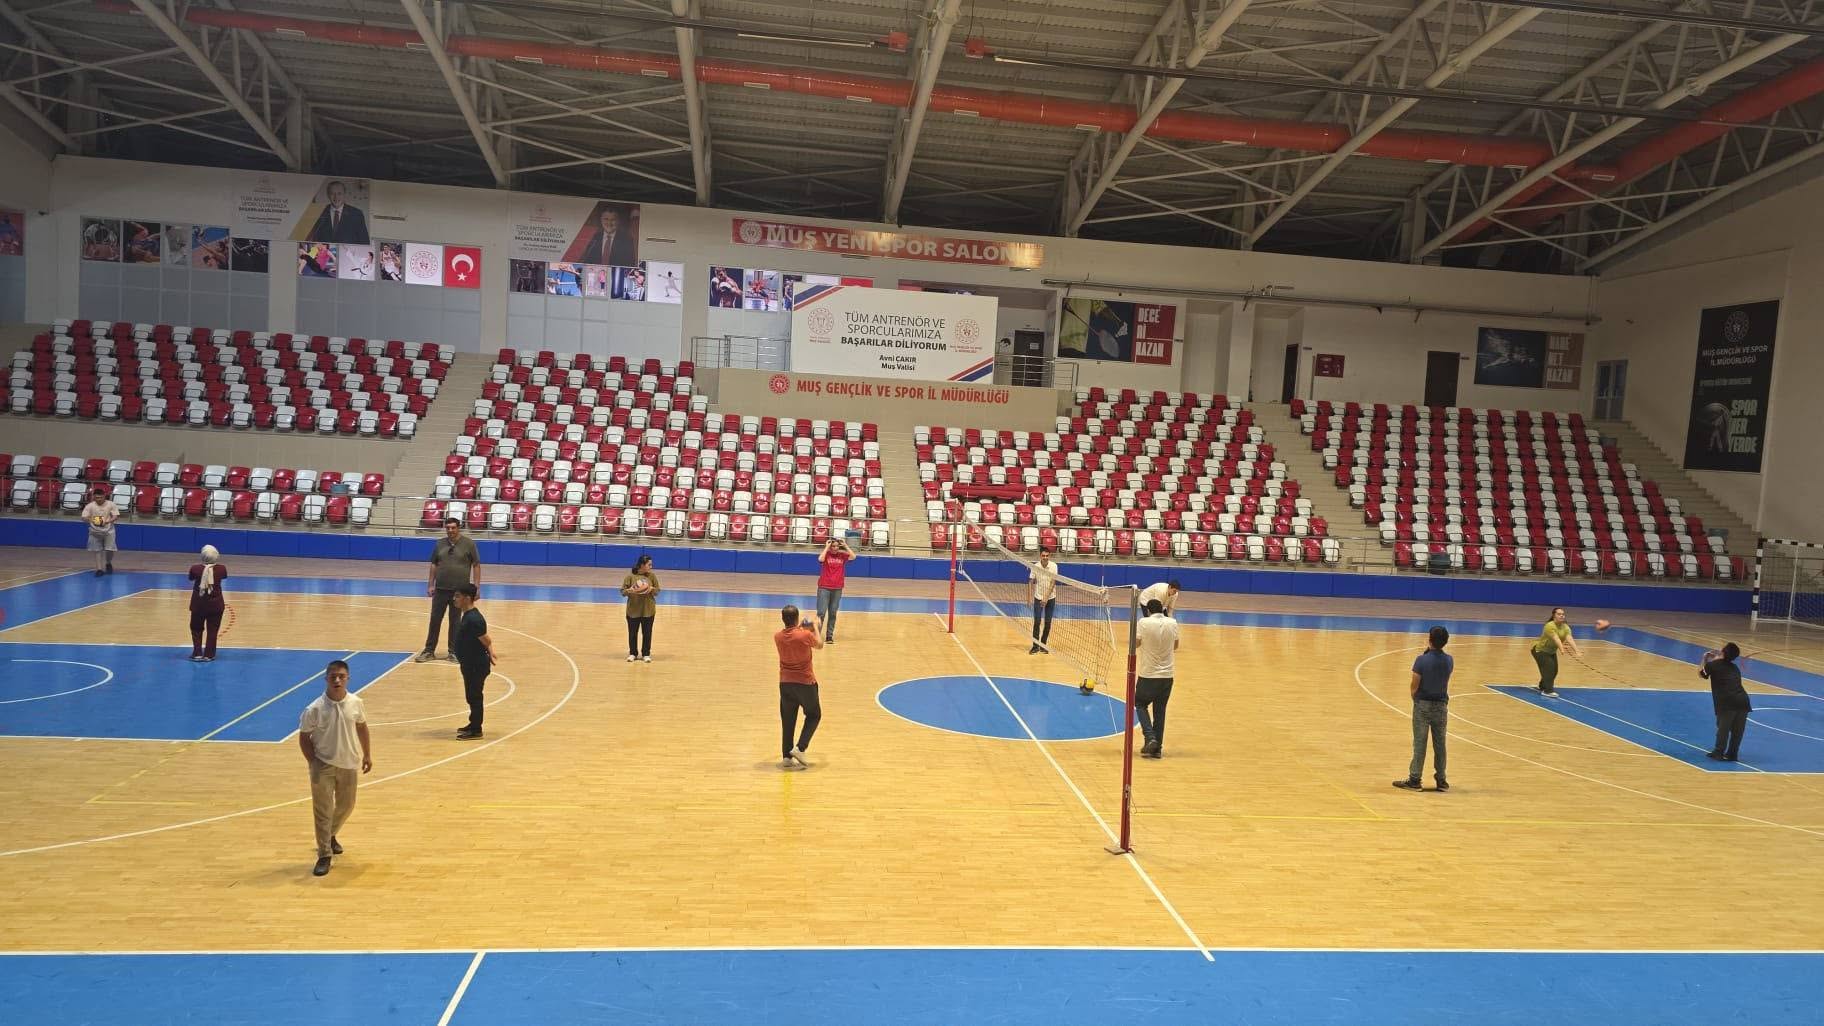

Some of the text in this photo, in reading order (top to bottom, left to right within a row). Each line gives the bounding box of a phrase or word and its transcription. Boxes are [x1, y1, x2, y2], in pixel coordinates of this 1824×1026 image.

[766, 225, 817, 250] MUŞ
[879, 237, 938, 257] SPOR
[844, 311, 946, 329] TÜM ANTRENÖR VE
[847, 324, 942, 340] SPORCULARIMIZA
[841, 336, 893, 348] BAŞARILAR
[895, 339, 947, 351] DİLİYORUM
[879, 354, 895, 362] Avni
[796, 379, 1009, 404] MUŞ GENÇLİK VE SPOR İL MÜDÜRLÜĞÜ
[1731, 399, 1758, 416] SPOR
[1728, 436, 1758, 453] YERDE
